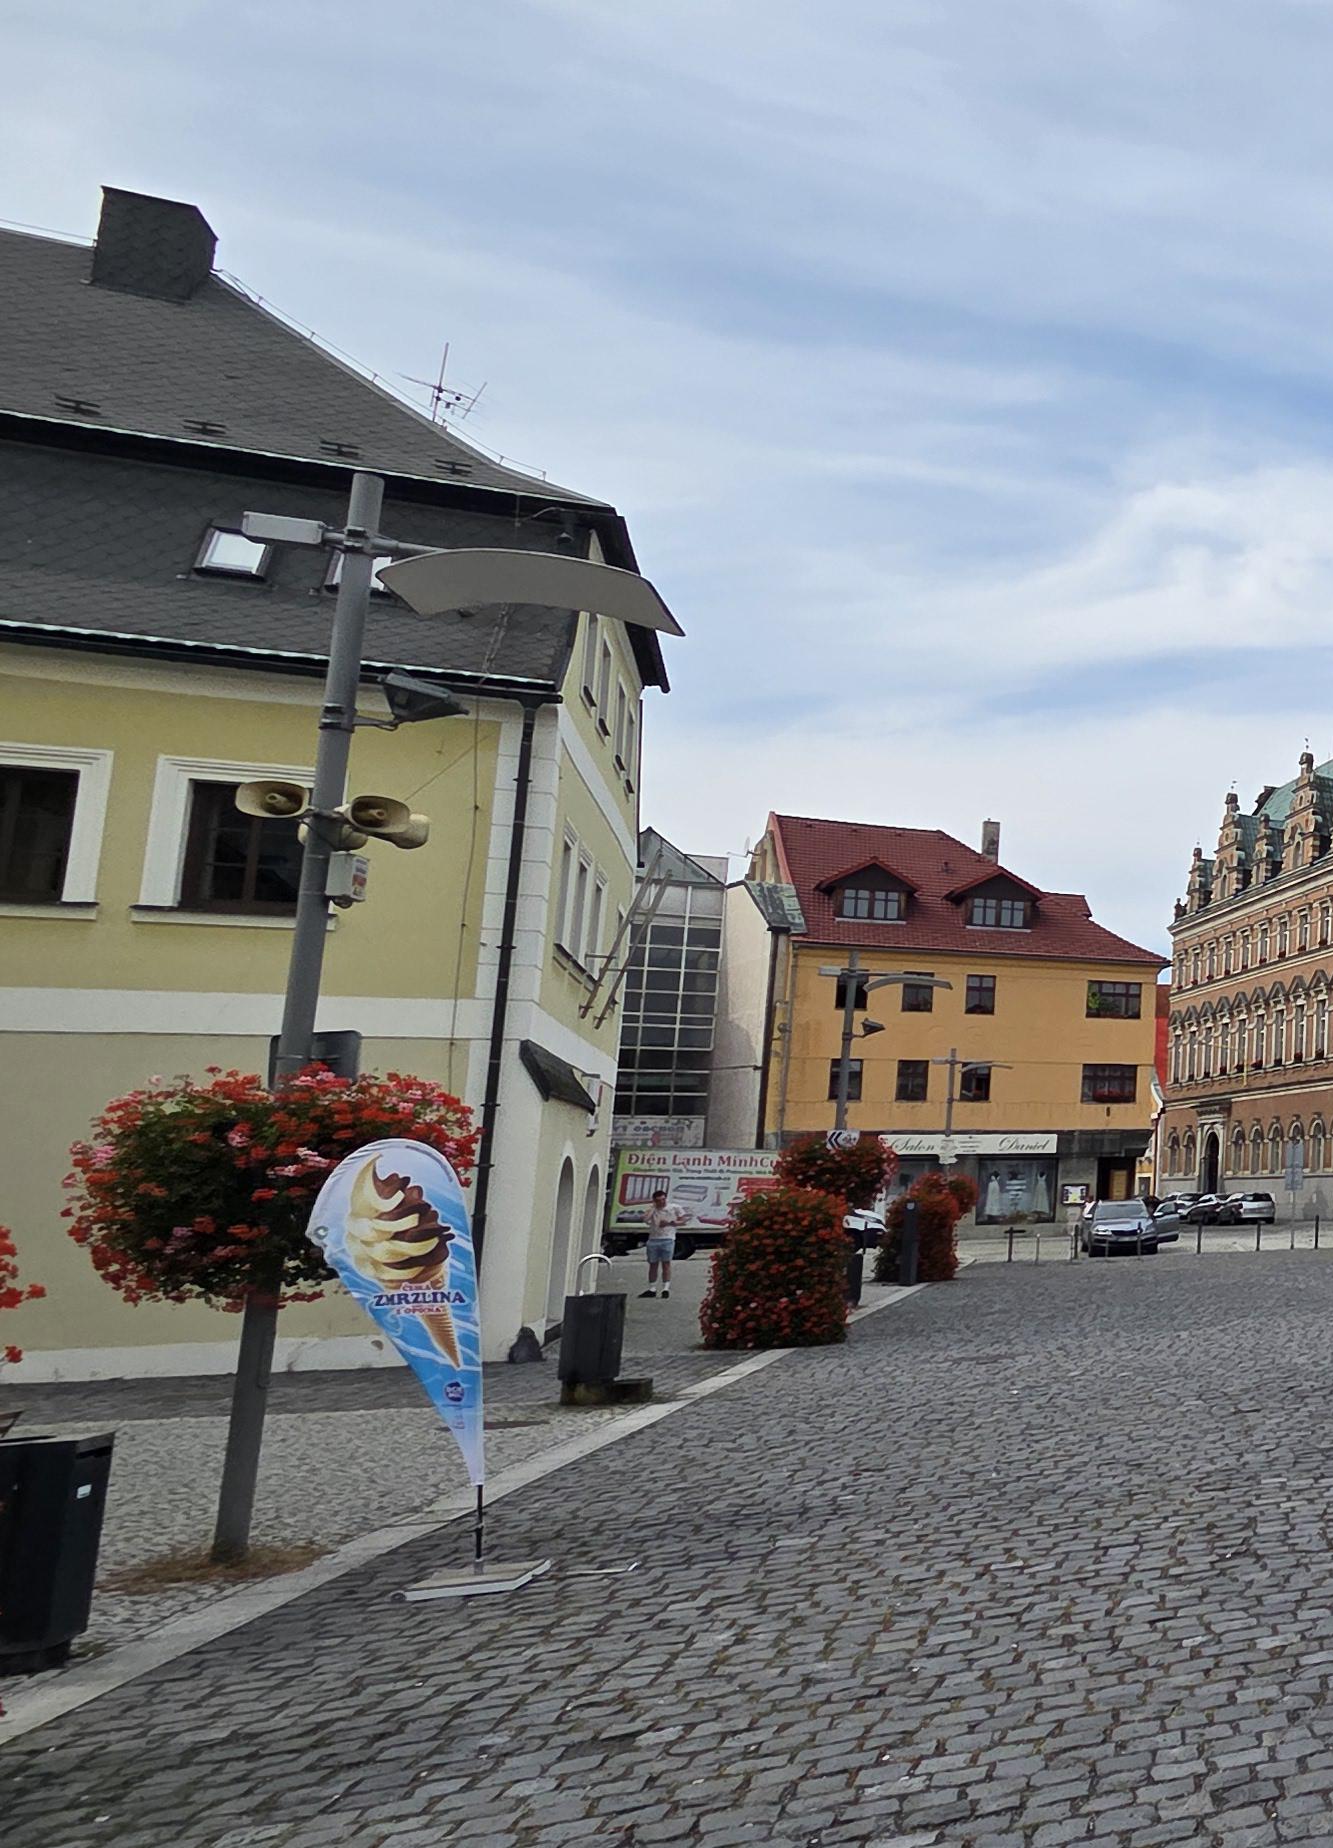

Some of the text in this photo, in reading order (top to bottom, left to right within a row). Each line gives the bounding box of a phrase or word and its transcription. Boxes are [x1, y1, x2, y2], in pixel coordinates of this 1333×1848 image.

[890, 1136, 935, 1151] Salon
[998, 1136, 1050, 1151] Daniel
[717, 1155, 777, 1168] MinhCu
[373, 1291, 466, 1306] ZMRZLINA
